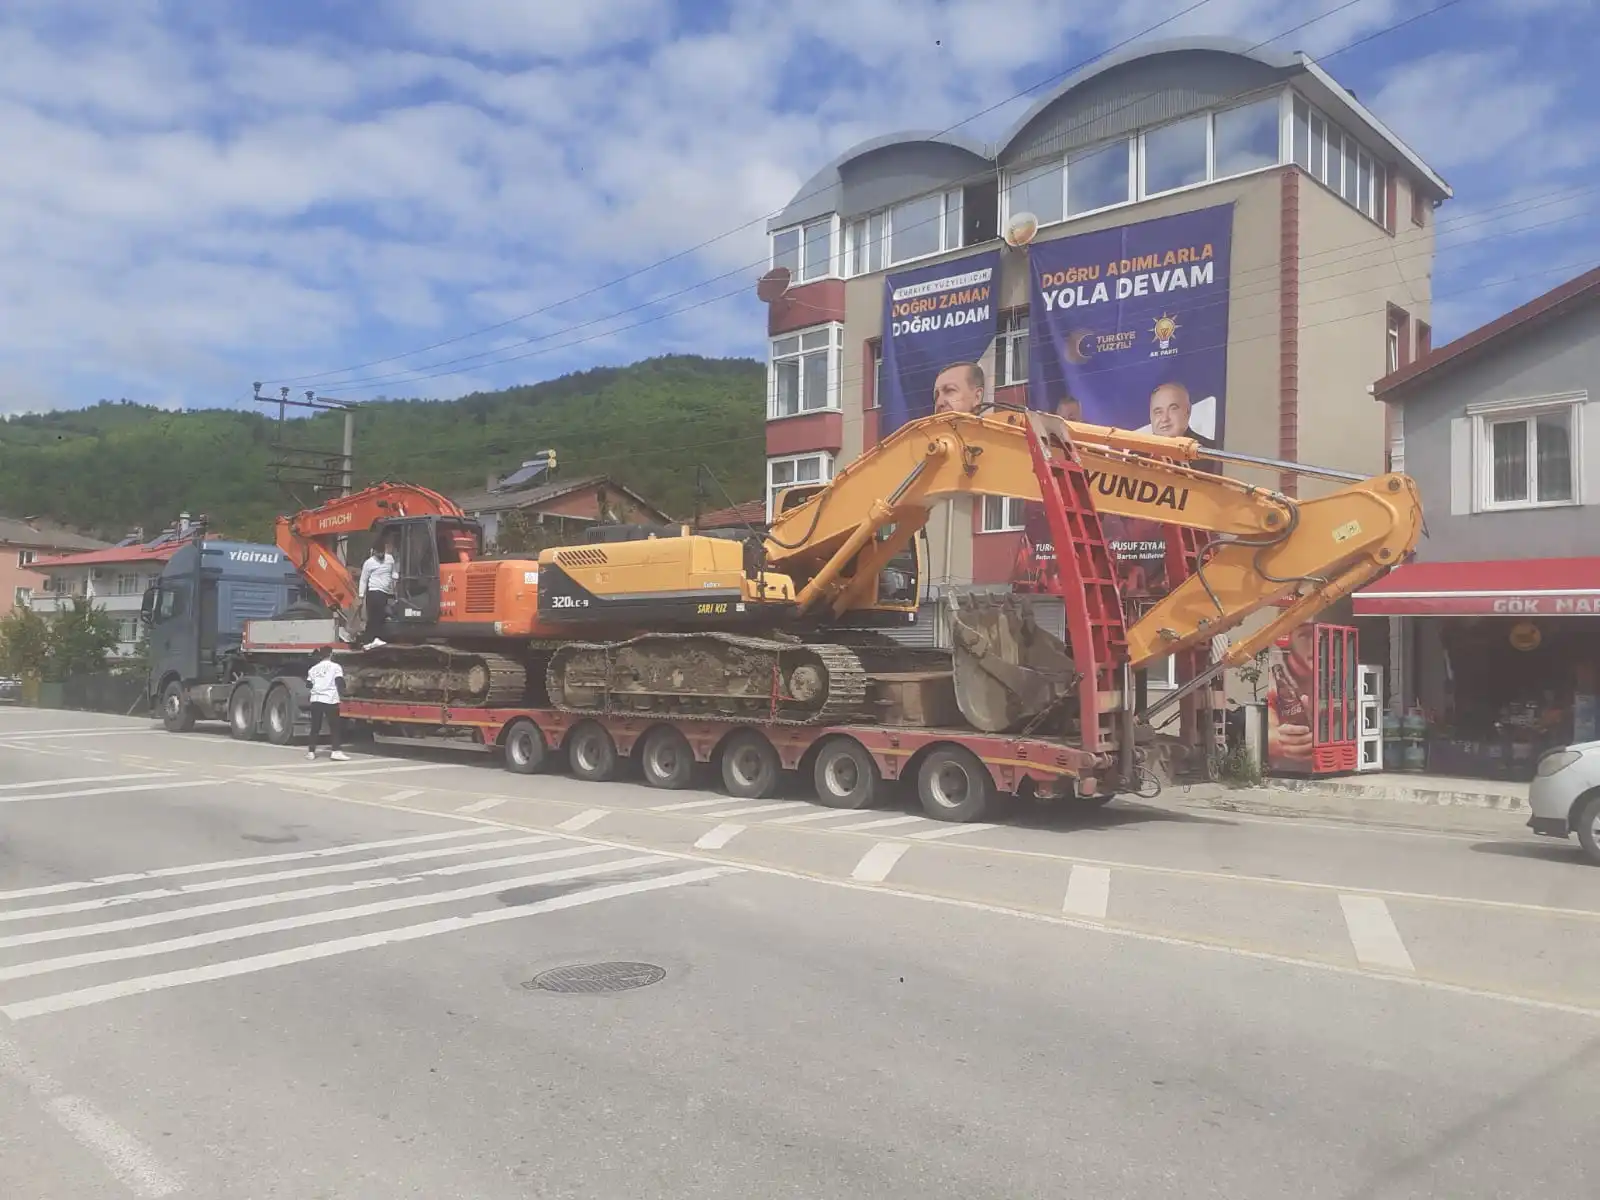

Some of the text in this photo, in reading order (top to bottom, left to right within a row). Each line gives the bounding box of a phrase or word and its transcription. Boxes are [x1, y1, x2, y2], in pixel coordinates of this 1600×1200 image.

[1042, 243, 1214, 289] DOĞRU ADIMLARLA
[892, 286, 990, 317] DOĞRU ZAMAN
[1042, 261, 1214, 312] YOLA DEVAM
[892, 304, 990, 336] DOĞRU ADAM
[1084, 468, 1189, 511] YUNDAI
[319, 511, 352, 529] HITACHI
[1112, 541, 1138, 551] YUSUF
[697, 603, 714, 614] SARI
[1493, 597, 1540, 613] GÖK
